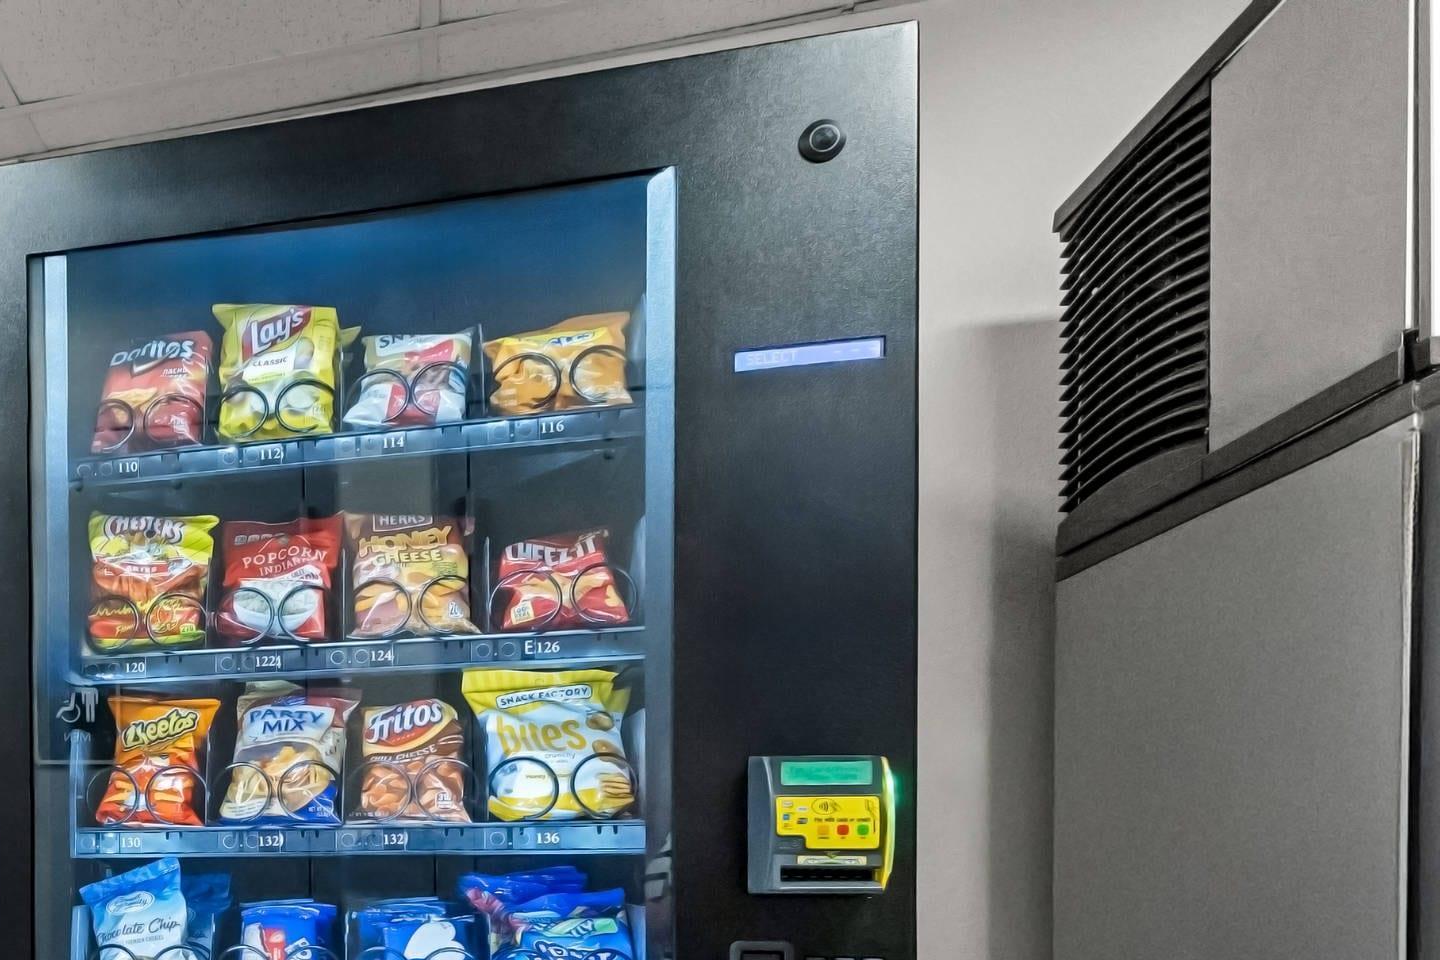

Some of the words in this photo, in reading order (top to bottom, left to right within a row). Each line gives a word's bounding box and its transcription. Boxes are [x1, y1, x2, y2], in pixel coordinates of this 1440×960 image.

[249, 307, 304, 354] Lay's
[110, 340, 195, 367] Doritos
[252, 356, 287, 367] CLASSIC
[541, 422, 564, 434] 116
[382, 436, 405, 449] 114
[260, 448, 281, 460] 112
[118, 461, 138, 473] 110
[359, 526, 452, 558] HONEY
[242, 546, 327, 568] POPCORN
[373, 549, 442, 567] CHEESE
[537, 641, 560, 654] 126
[370, 649, 392, 662] 124
[125, 662, 146, 673] 120
[501, 693, 535, 706] SNACK
[250, 708, 325, 724] PARTY
[262, 718, 306, 734] MIX
[367, 702, 442, 744] Fritos
[122, 837, 141, 848] 130
[259, 836, 279, 848] 132
[383, 833, 404, 845] 132
[536, 832, 559, 844] 136
[148, 917, 181, 934] Chip
